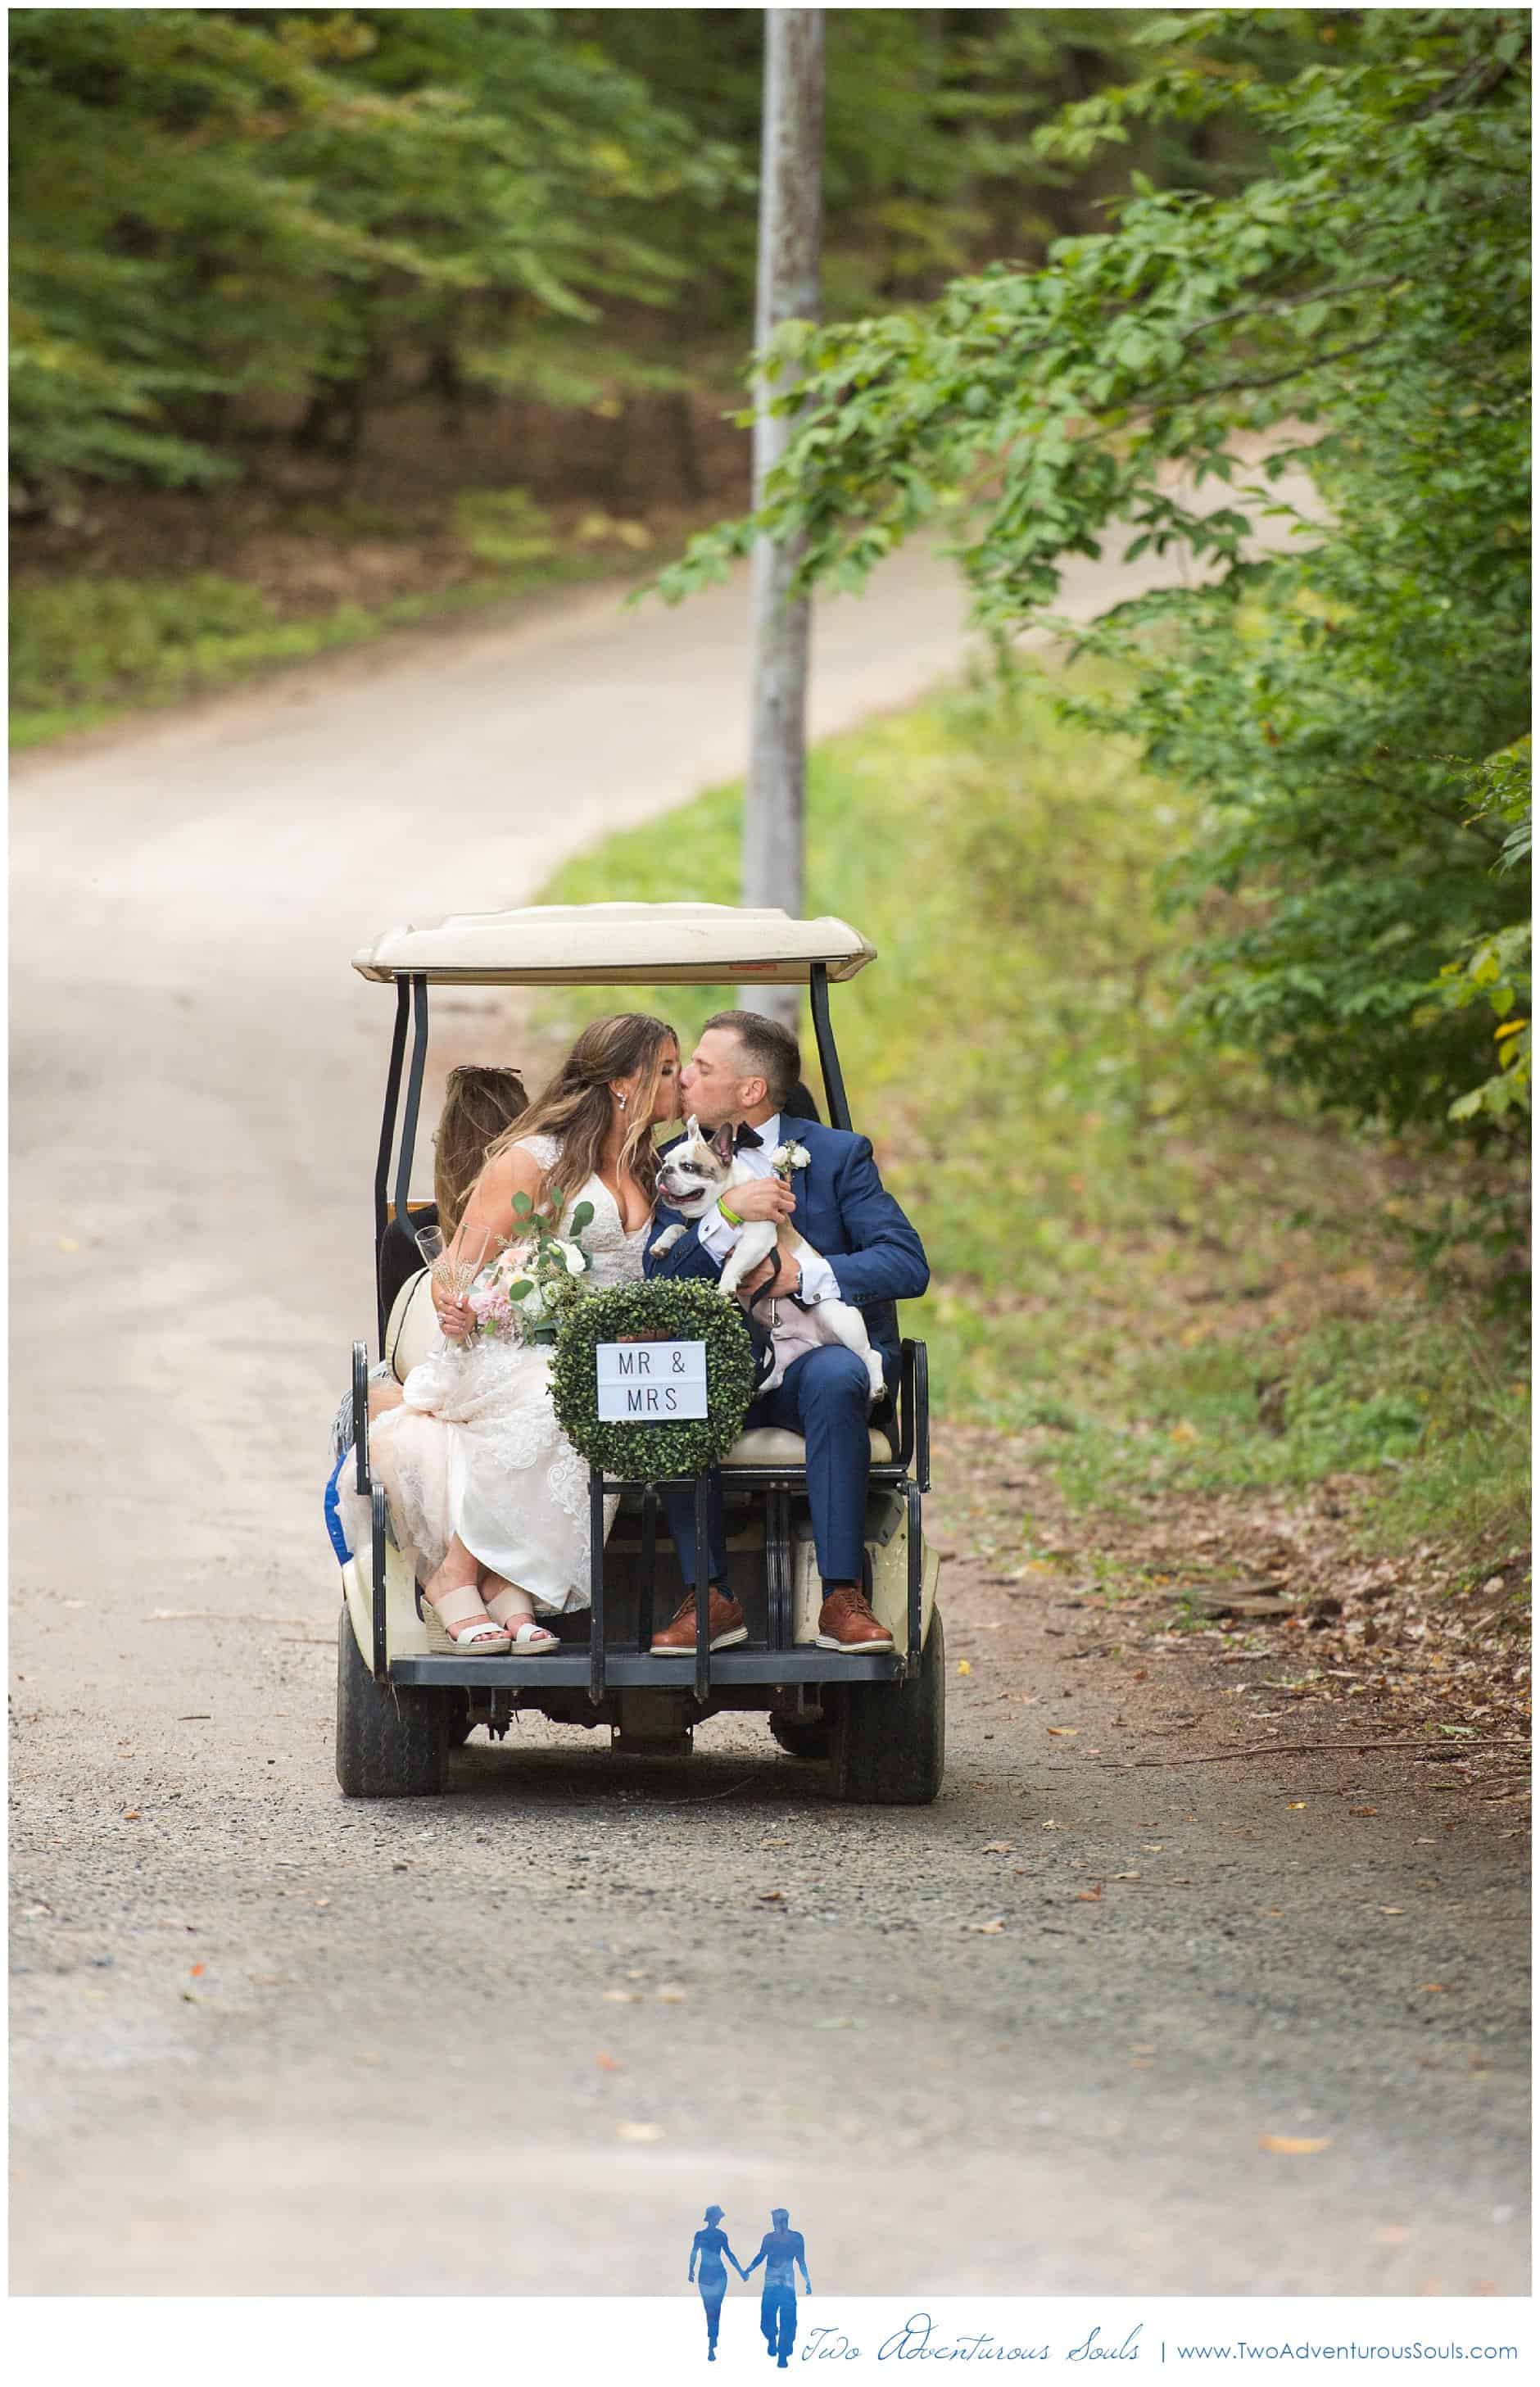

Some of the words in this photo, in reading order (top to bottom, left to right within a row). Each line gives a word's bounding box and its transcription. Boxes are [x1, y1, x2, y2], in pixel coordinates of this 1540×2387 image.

[618, 1352, 650, 1375] MR
[672, 1351, 685, 1373] &
[627, 1388, 677, 1411] MRS
